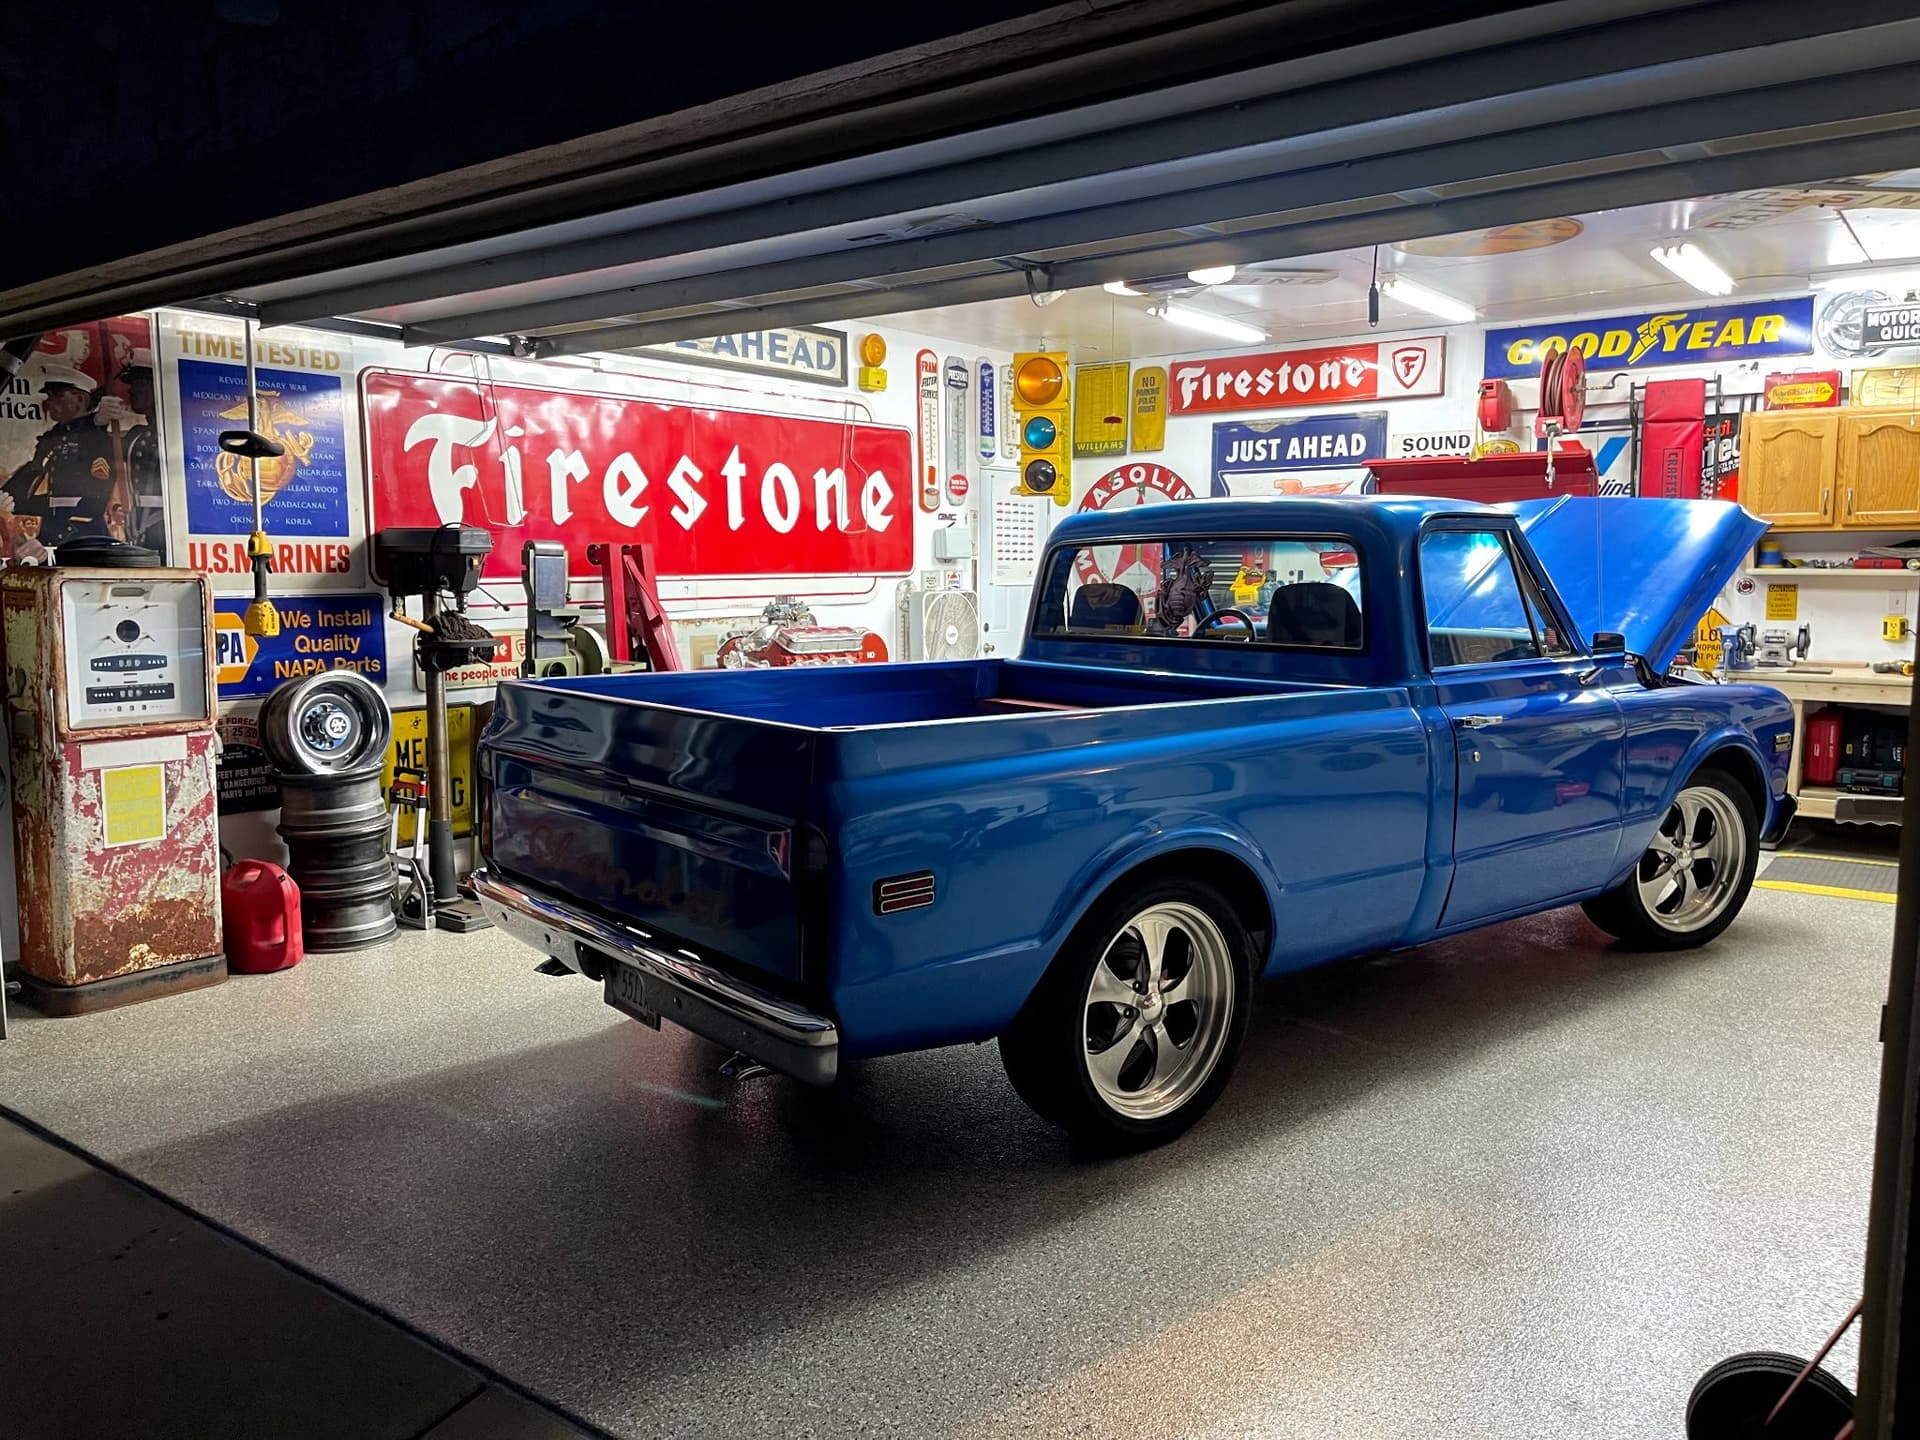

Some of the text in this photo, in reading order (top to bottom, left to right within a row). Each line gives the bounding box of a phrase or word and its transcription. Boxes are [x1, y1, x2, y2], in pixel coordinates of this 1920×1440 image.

[176, 330, 341, 371] TIME TESTED
[711, 331, 836, 371] AHEAD
[289, 383, 308, 392] WAR
[1142, 376, 1156, 388] NO
[1176, 357, 1366, 409] Firestone
[1077, 441, 1124, 451] WILLIAMS
[1225, 433, 1366, 464] JUST AHEAD
[1402, 434, 1470, 452] SOUND
[403, 412, 895, 534] Firestone
[313, 485, 339, 493] WOOD
[269, 500, 327, 510] GUADALCANAL
[285, 517, 312, 525] KOREA
[280, 608, 371, 629] We Install
[295, 634, 360, 654] Quality
[275, 656, 382, 679] NAPA Parts
[462, 667, 498, 682] people
